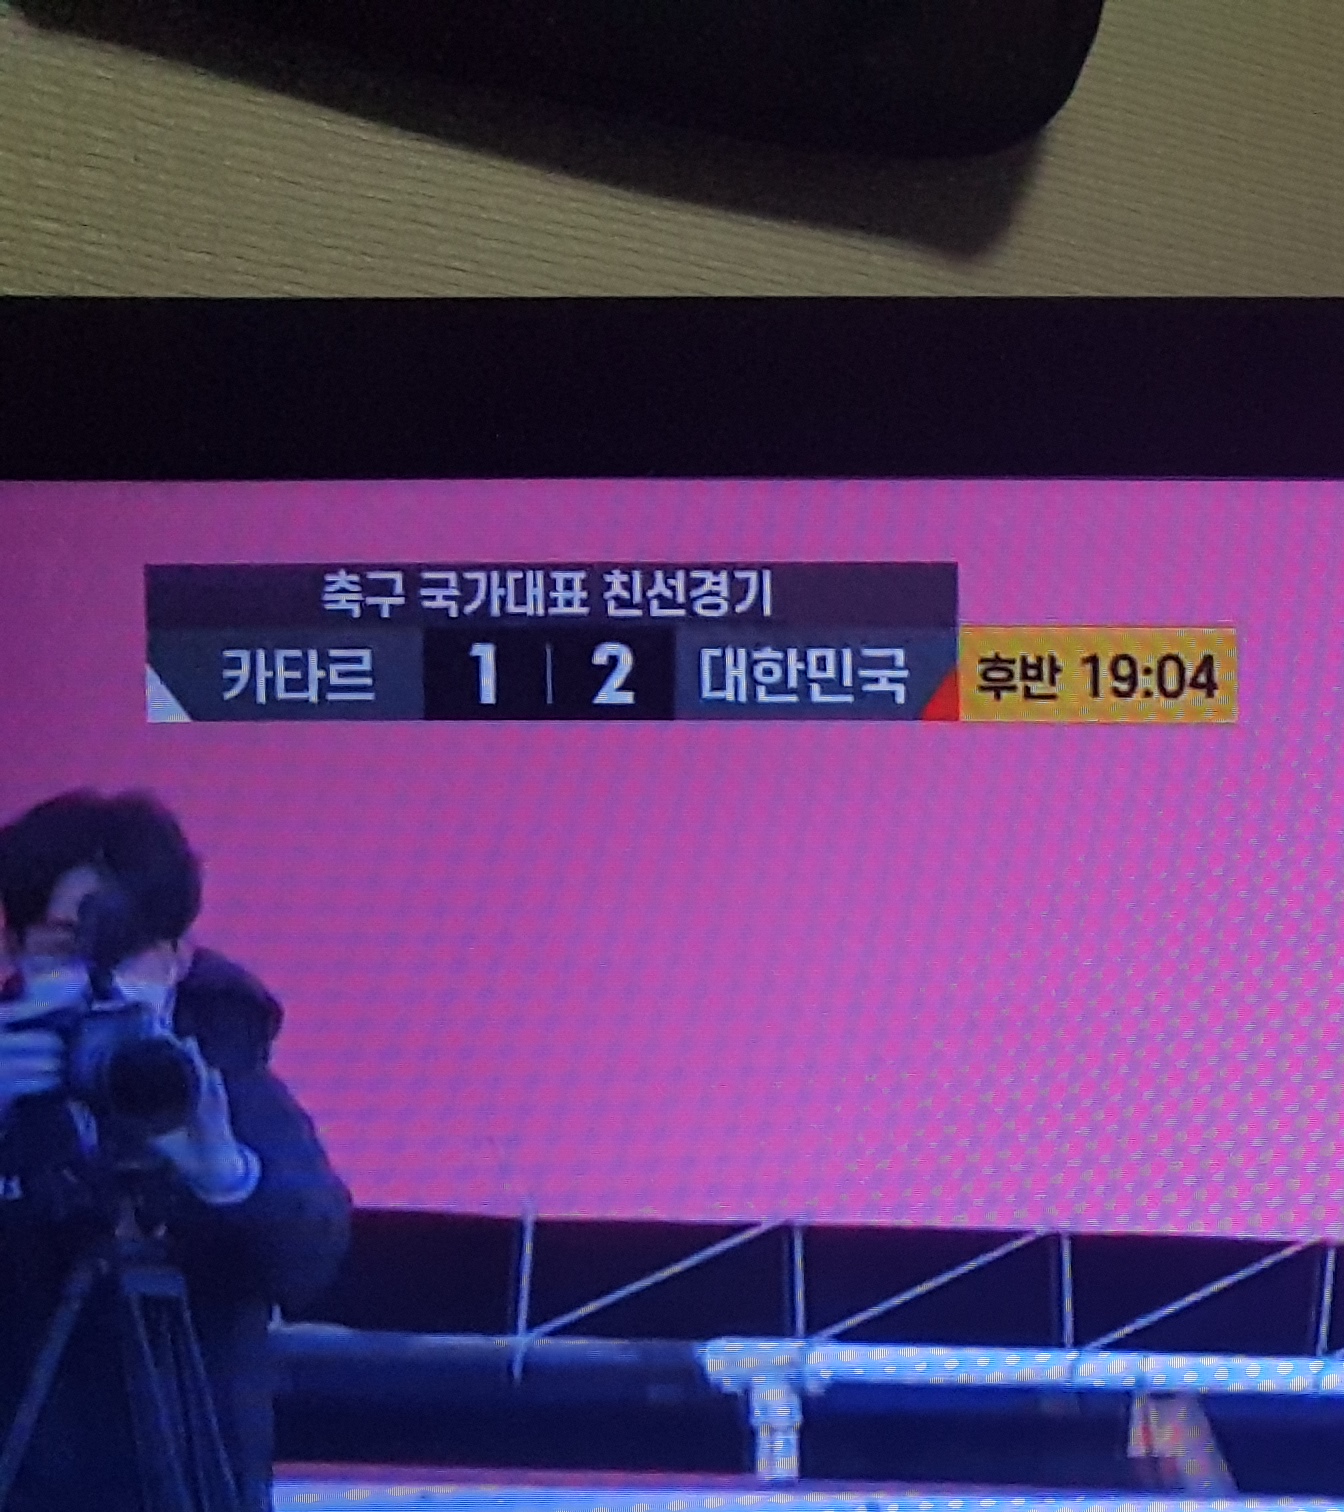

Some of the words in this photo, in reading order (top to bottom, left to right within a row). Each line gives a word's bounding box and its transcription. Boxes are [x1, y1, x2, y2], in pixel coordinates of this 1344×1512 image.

[322, 568, 405, 618] 축구
[419, 568, 591, 618] 국가대표
[602, 568, 773, 618] 친선경기
[220, 646, 377, 705] 카타르
[468, 641, 498, 705] 1
[591, 642, 635, 705] 2
[699, 645, 911, 706] 대한민국
[976, 651, 1063, 702] 후반
[1079, 652, 1219, 700] 19:04
